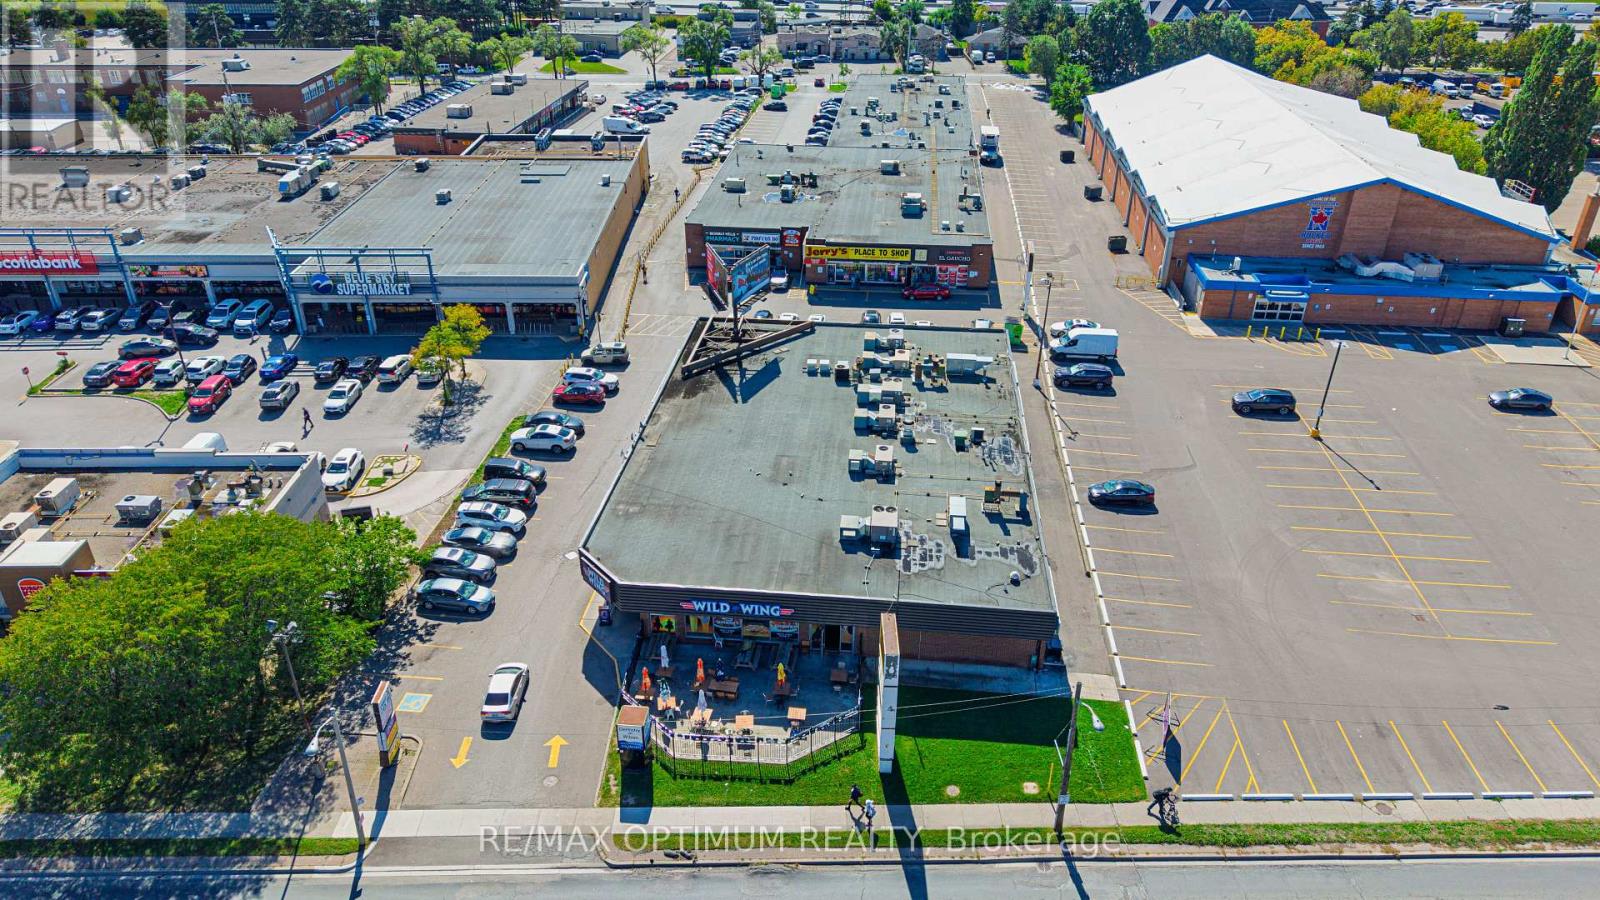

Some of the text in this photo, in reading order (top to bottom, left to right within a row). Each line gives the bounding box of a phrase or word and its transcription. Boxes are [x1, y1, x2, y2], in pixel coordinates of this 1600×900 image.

[806, 247, 910, 257] Jerry's PLACE TO SHOP
[344, 272, 396, 284] BLUE SKY
[337, 283, 411, 296] SUPERMARKET
[692, 600, 781, 617] WILD WING
